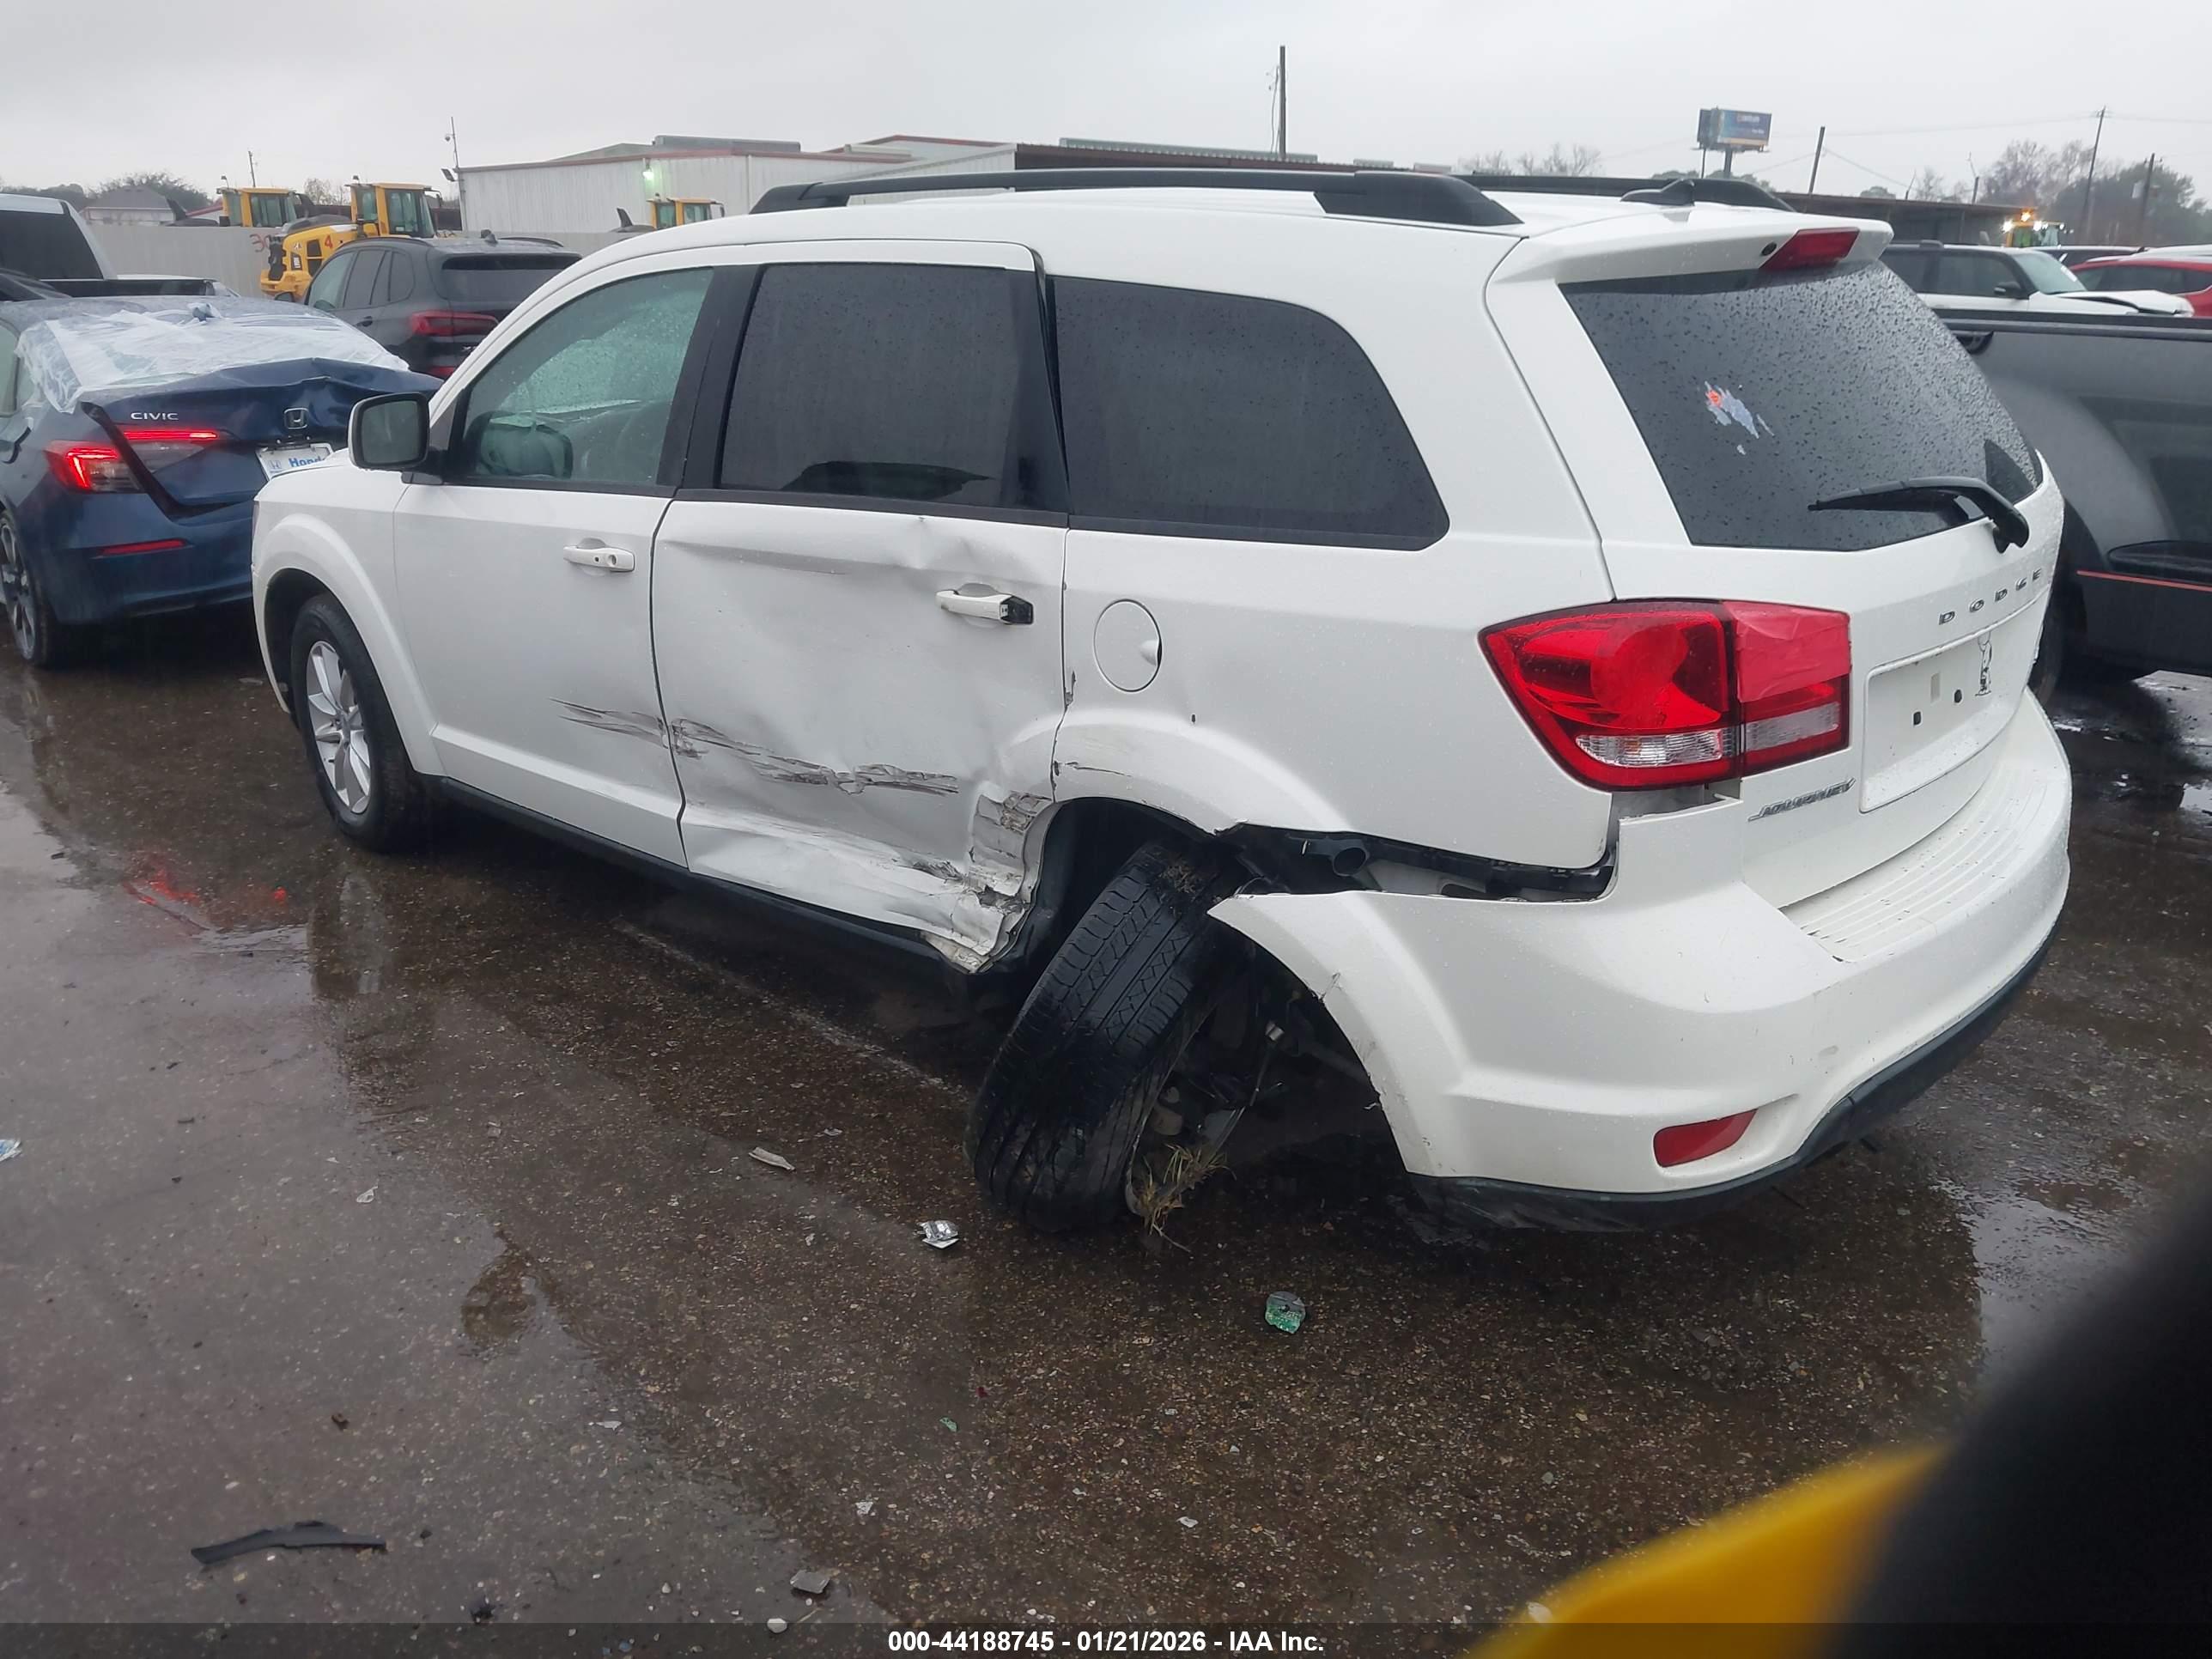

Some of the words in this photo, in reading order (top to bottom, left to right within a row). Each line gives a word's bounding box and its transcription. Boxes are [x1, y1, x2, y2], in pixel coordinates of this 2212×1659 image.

[131, 412, 179, 421] CIVIC
[289, 456, 326, 468] Hond
[1938, 568, 2042, 625] DODGE
